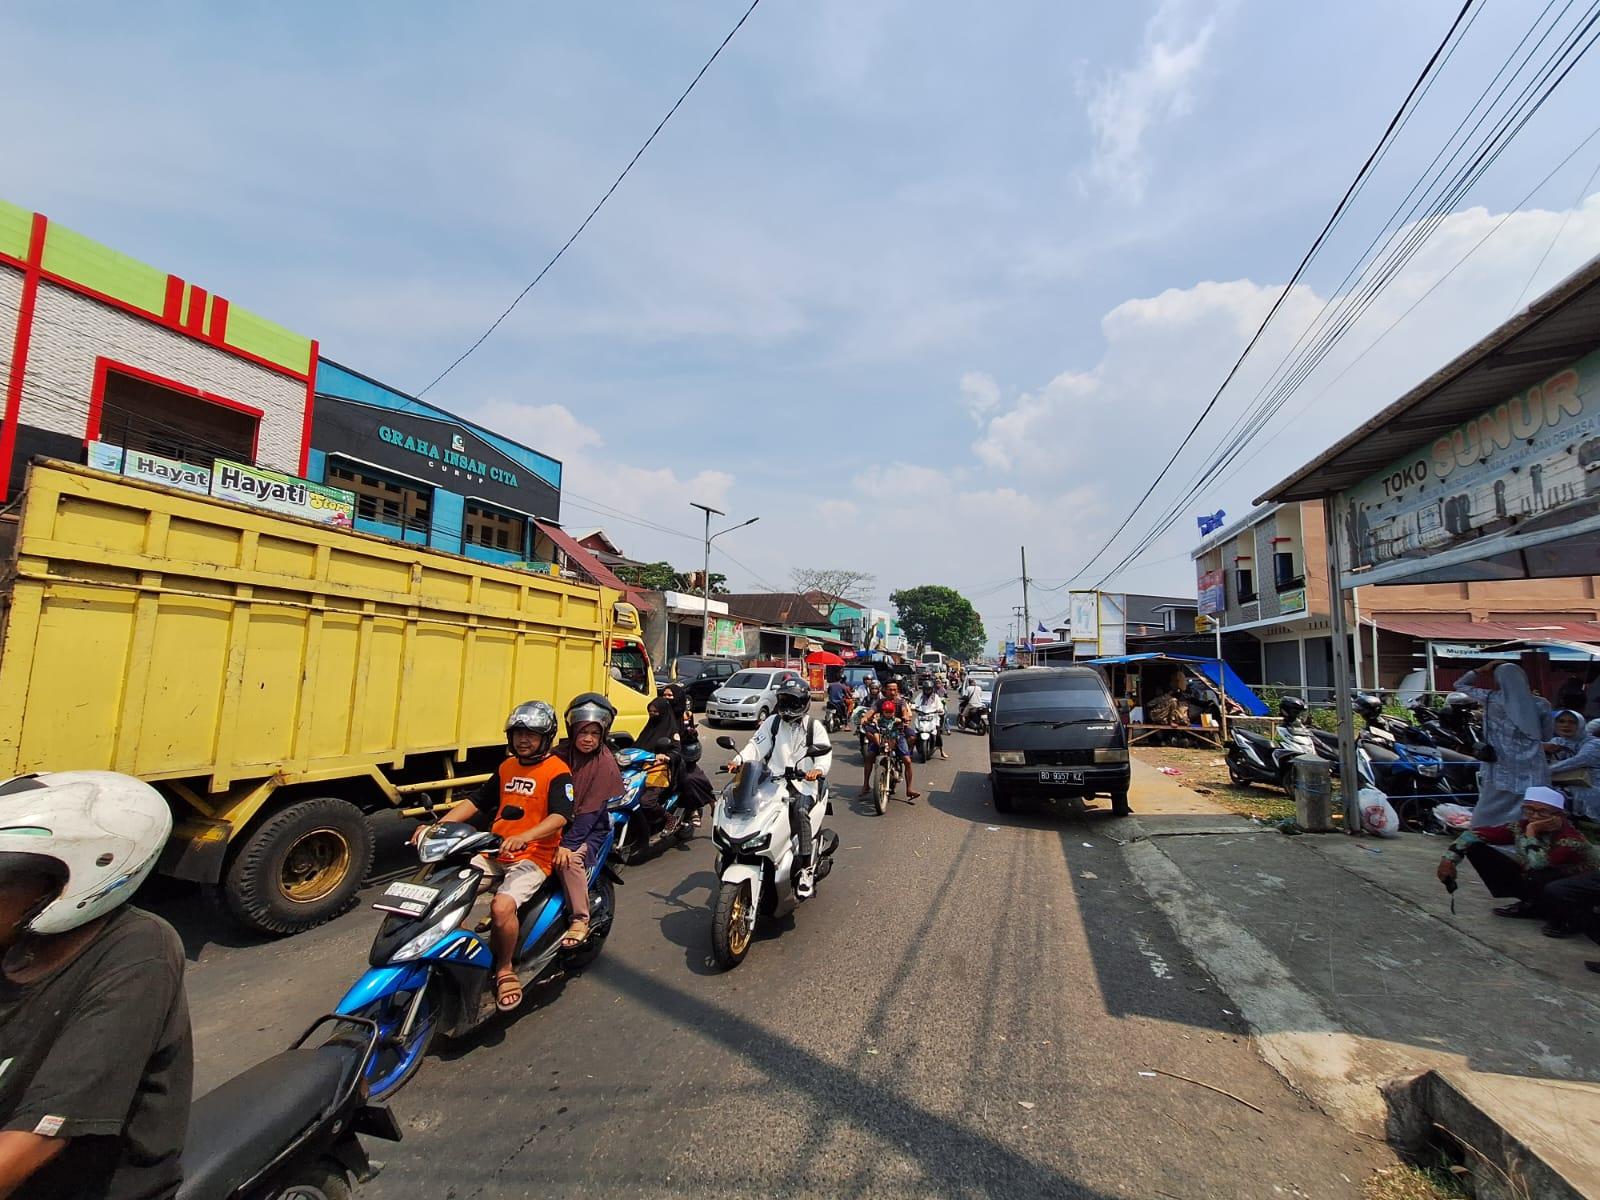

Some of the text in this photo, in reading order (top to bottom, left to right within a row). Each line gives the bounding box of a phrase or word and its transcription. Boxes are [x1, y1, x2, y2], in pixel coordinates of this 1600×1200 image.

[1382, 460, 1427, 497] TOKO
[1432, 369, 1583, 478] SUNUR
[137, 456, 210, 486] Hayat
[379, 425, 519, 487] GRAHA INSAN CITA
[428, 461, 484, 485] CURUP
[220, 466, 306, 505] Hayati
[308, 491, 352, 514] Store
[505, 778, 535, 794] JTR
